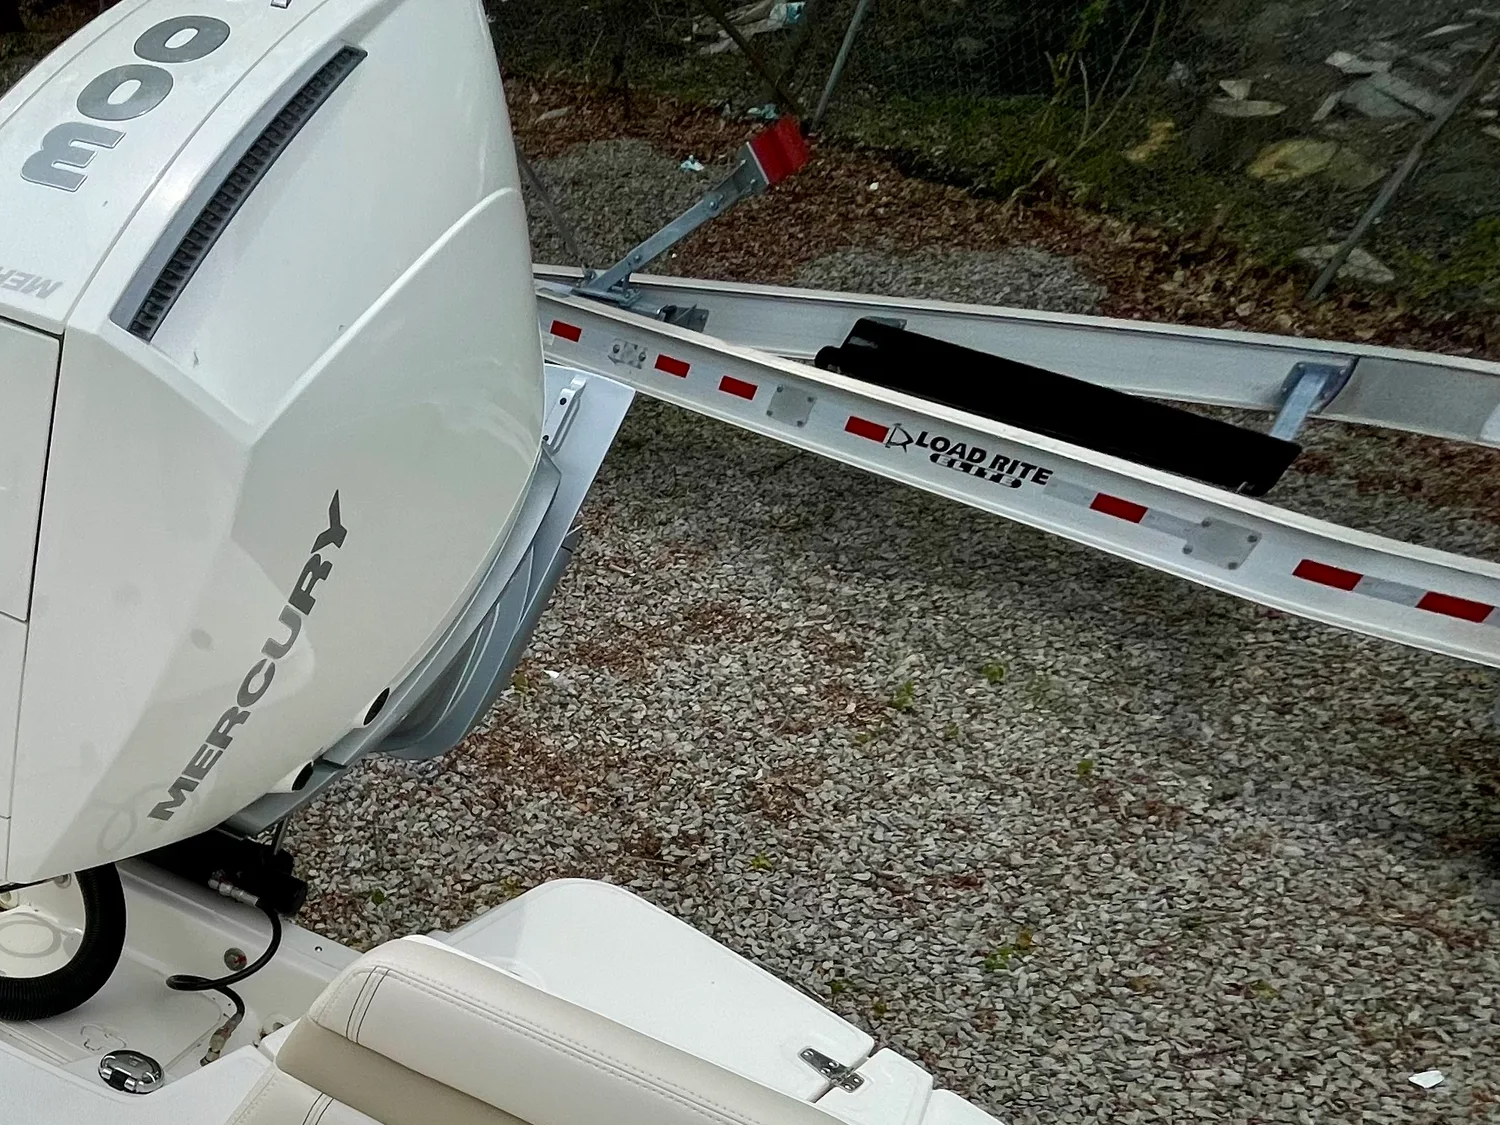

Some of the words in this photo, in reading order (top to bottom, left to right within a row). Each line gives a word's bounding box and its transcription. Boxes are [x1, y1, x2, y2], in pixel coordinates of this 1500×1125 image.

[20, 15, 231, 192] 300
[915, 431, 988, 464] LOAD
[989, 454, 1054, 486] RITE
[935, 455, 1015, 487] ELITE
[147, 489, 348, 822] MERCURY
